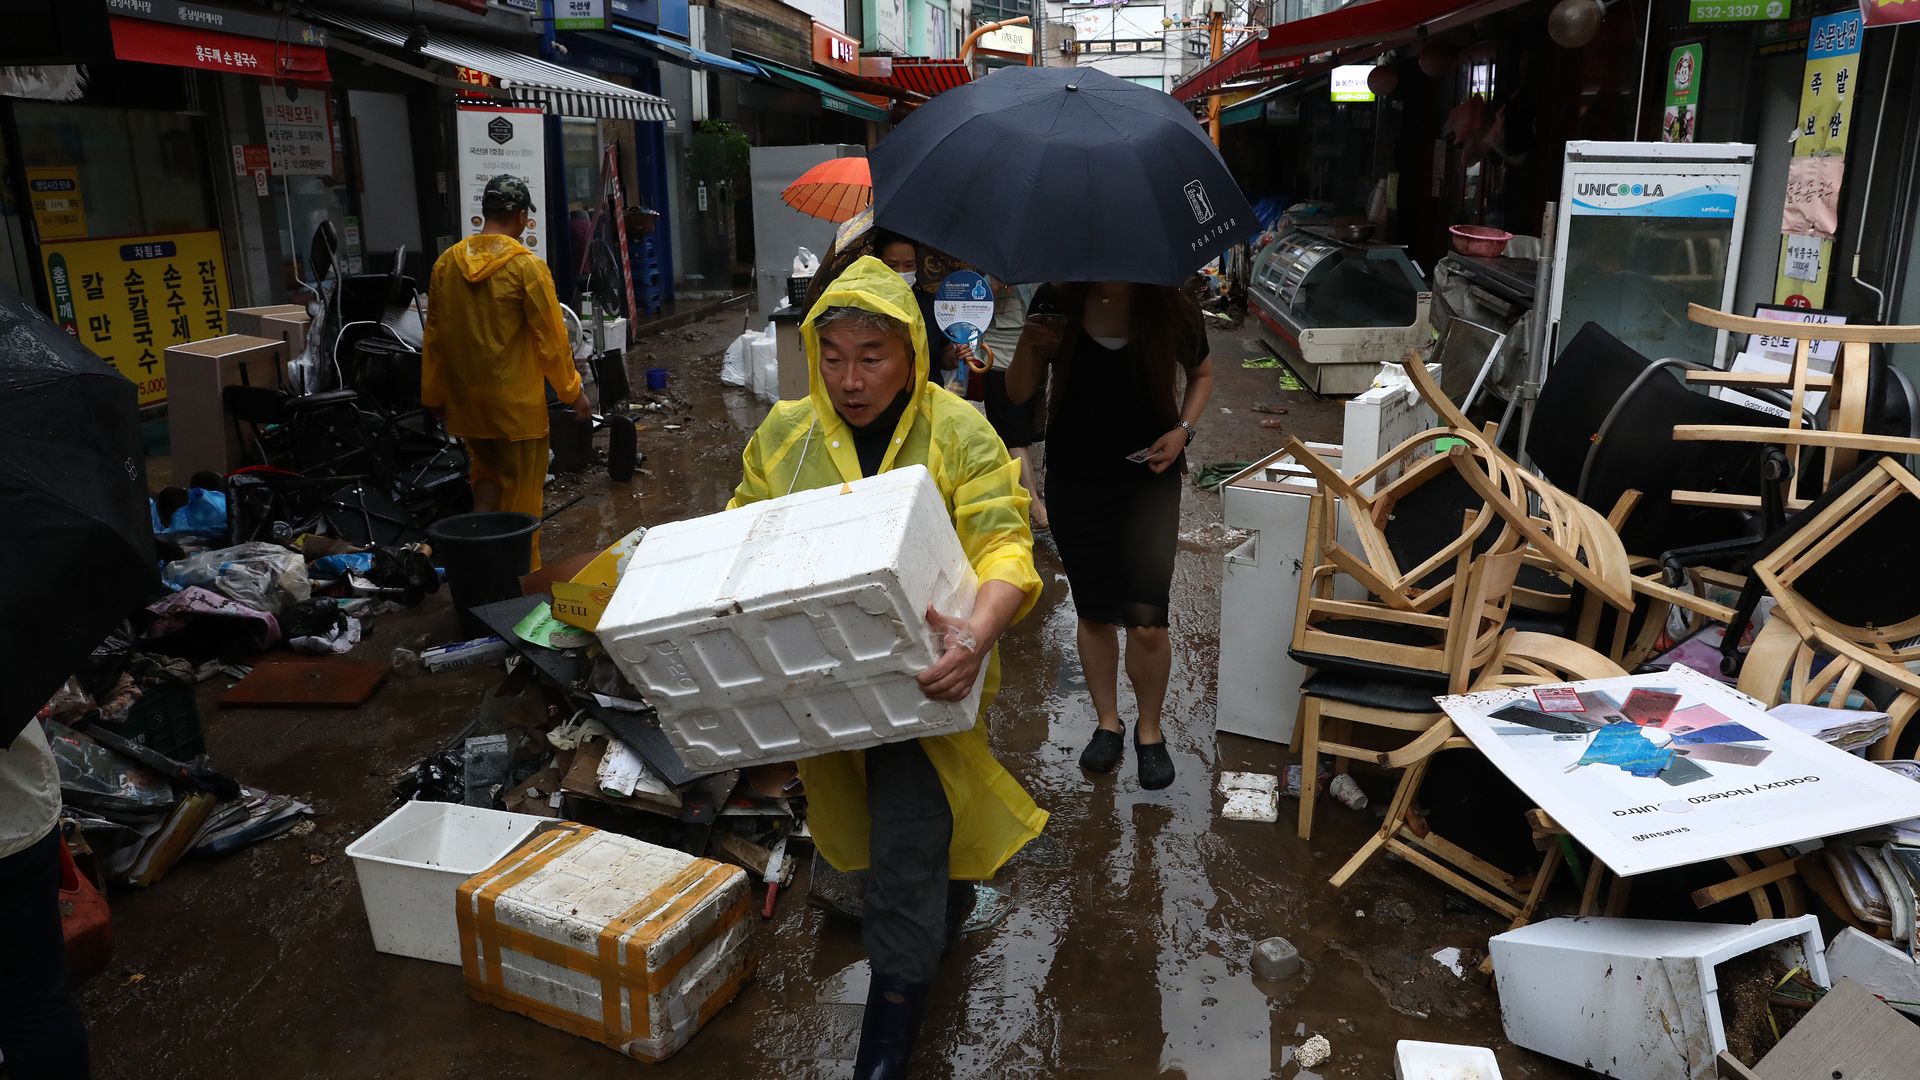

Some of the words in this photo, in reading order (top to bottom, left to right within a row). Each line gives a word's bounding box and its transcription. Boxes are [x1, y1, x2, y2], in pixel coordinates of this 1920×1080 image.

[570, 1, 591, 11] 국선생
[1696, 6, 1759, 19] 532-3307
[1814, 19, 1858, 51] 소문난집
[195, 45, 221, 64] 홍두깨
[223, 51, 233, 66] 손
[233, 51, 258, 68] 칼국수
[1811, 69, 1849, 97] 족발
[277, 104, 313, 123] 직원모집
[1804, 113, 1842, 138] 보쌈
[1577, 183, 1665, 198] UNICOOLA
[134, 246, 163, 259] 차림표
[53, 265, 74, 319] 홍두깨
[197, 259, 221, 338] 잔치국
[162, 263, 193, 343] 손수제
[124, 267, 159, 375] 손칼국수
[1753, 775, 1821, 792] Galaxy
[1687, 787, 1754, 805] Note20
[1612, 804, 1659, 818] Ultra
[1632, 827, 1690, 842] SAMSUNG
